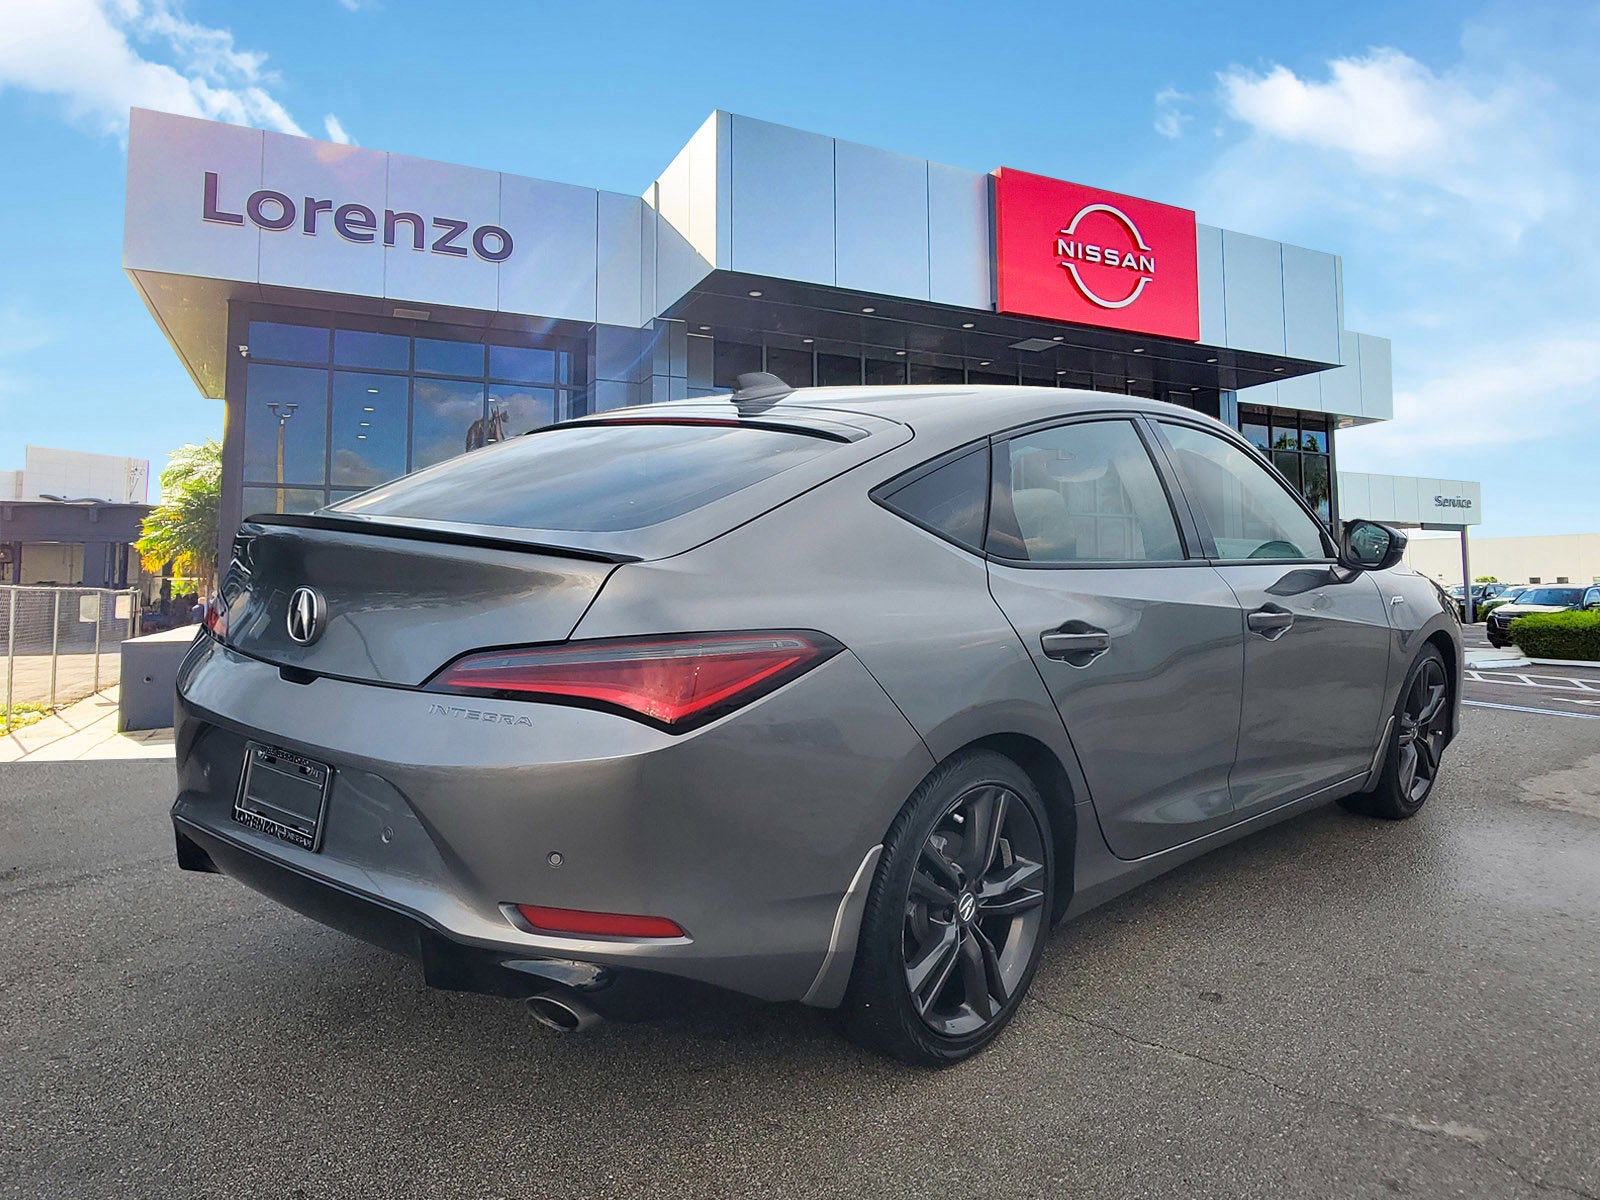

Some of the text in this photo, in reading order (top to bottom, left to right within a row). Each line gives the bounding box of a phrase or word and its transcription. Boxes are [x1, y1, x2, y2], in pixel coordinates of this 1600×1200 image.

[203, 171, 515, 262] Lorenzo
[1057, 238, 1155, 273] NISSAN
[1434, 495, 1472, 508] Service
[428, 704, 533, 727] INTEGRA
